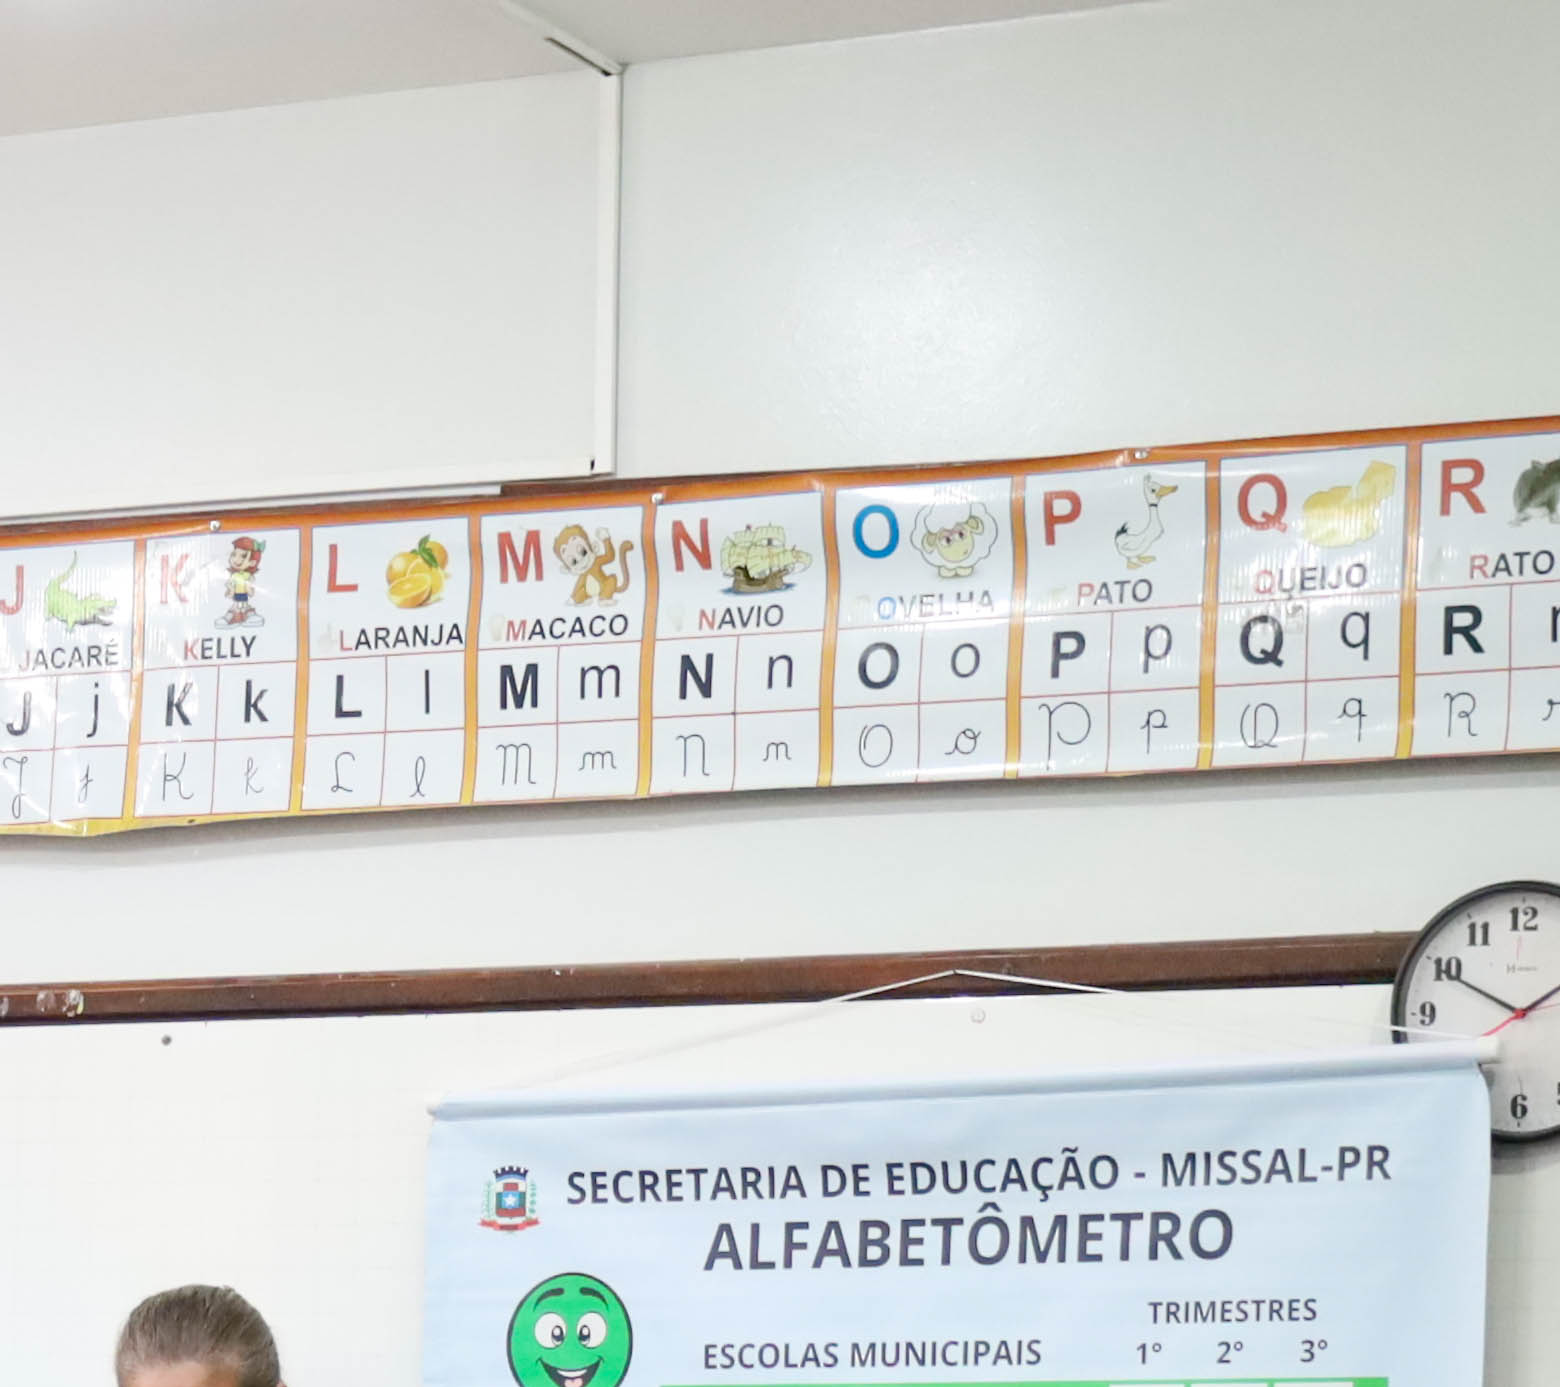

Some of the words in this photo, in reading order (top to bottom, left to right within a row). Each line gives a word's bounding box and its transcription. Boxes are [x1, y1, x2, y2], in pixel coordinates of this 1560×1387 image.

[1470, 550, 1555, 580] RATO
[1077, 579, 1152, 606] PATO
[1253, 563, 1368, 599] QUEIJO
[699, 604, 784, 631] NAVIO
[878, 590, 994, 619] OVELHA
[339, 622, 464, 652] LARANJA
[506, 614, 629, 642] MACACO
[19, 640, 119, 672] JACARÉ
[184, 636, 254, 661] KELLY
[1510, 906, 1538, 931] 12
[1467, 922, 1490, 946] 11
[1434, 956, 1462, 981] 10
[1420, 1002, 1436, 1026] 9
[1510, 1094, 1527, 1119] 6
[568, 1165, 807, 1204] SECRETARIA
[821, 1164, 870, 1197] DE
[886, 1147, 1119, 1201] EDUCAÇÃO
[1161, 1145, 1391, 1188] MISSAL-PR
[703, 1202, 1232, 1270] ALFABETÔMETRO
[1148, 1298, 1317, 1324] TRIMESTRES
[704, 1342, 839, 1369] ESCOLAS
[850, 1339, 1042, 1368] MUNICIPAIS
